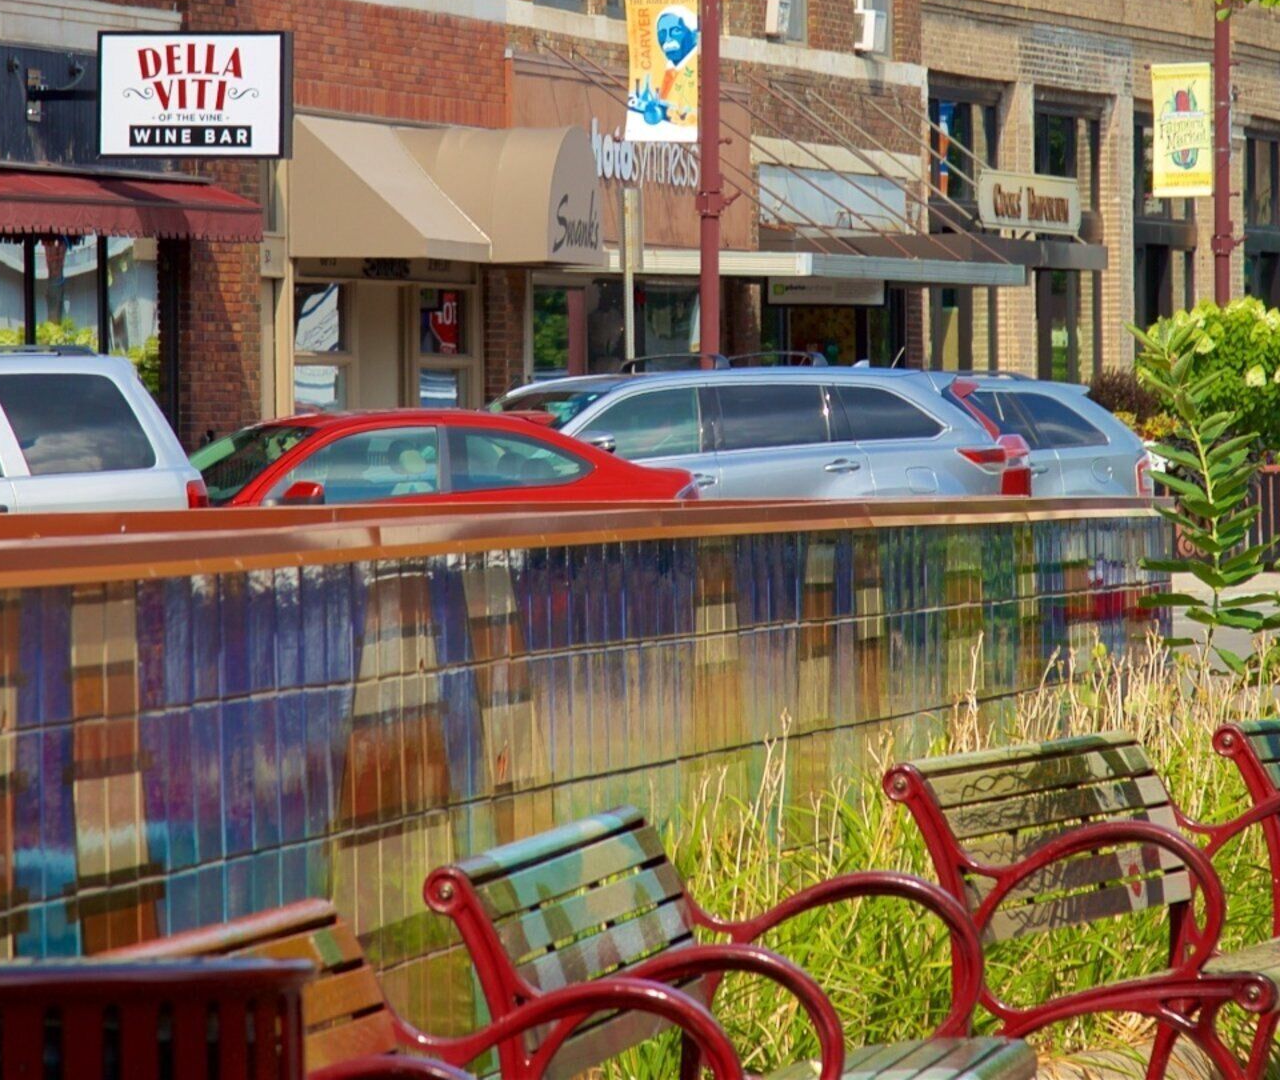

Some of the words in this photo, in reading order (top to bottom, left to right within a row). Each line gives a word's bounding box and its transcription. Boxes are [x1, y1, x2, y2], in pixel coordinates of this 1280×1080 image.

[638, 8, 652, 70] CARVER
[137, 43, 243, 80] DELLA
[153, 79, 227, 111] VITI
[158, 114, 173, 122] OF
[176, 114, 195, 122] THE
[199, 114, 223, 122] VINE
[135, 128, 192, 144] WINE
[204, 128, 248, 144] BAR
